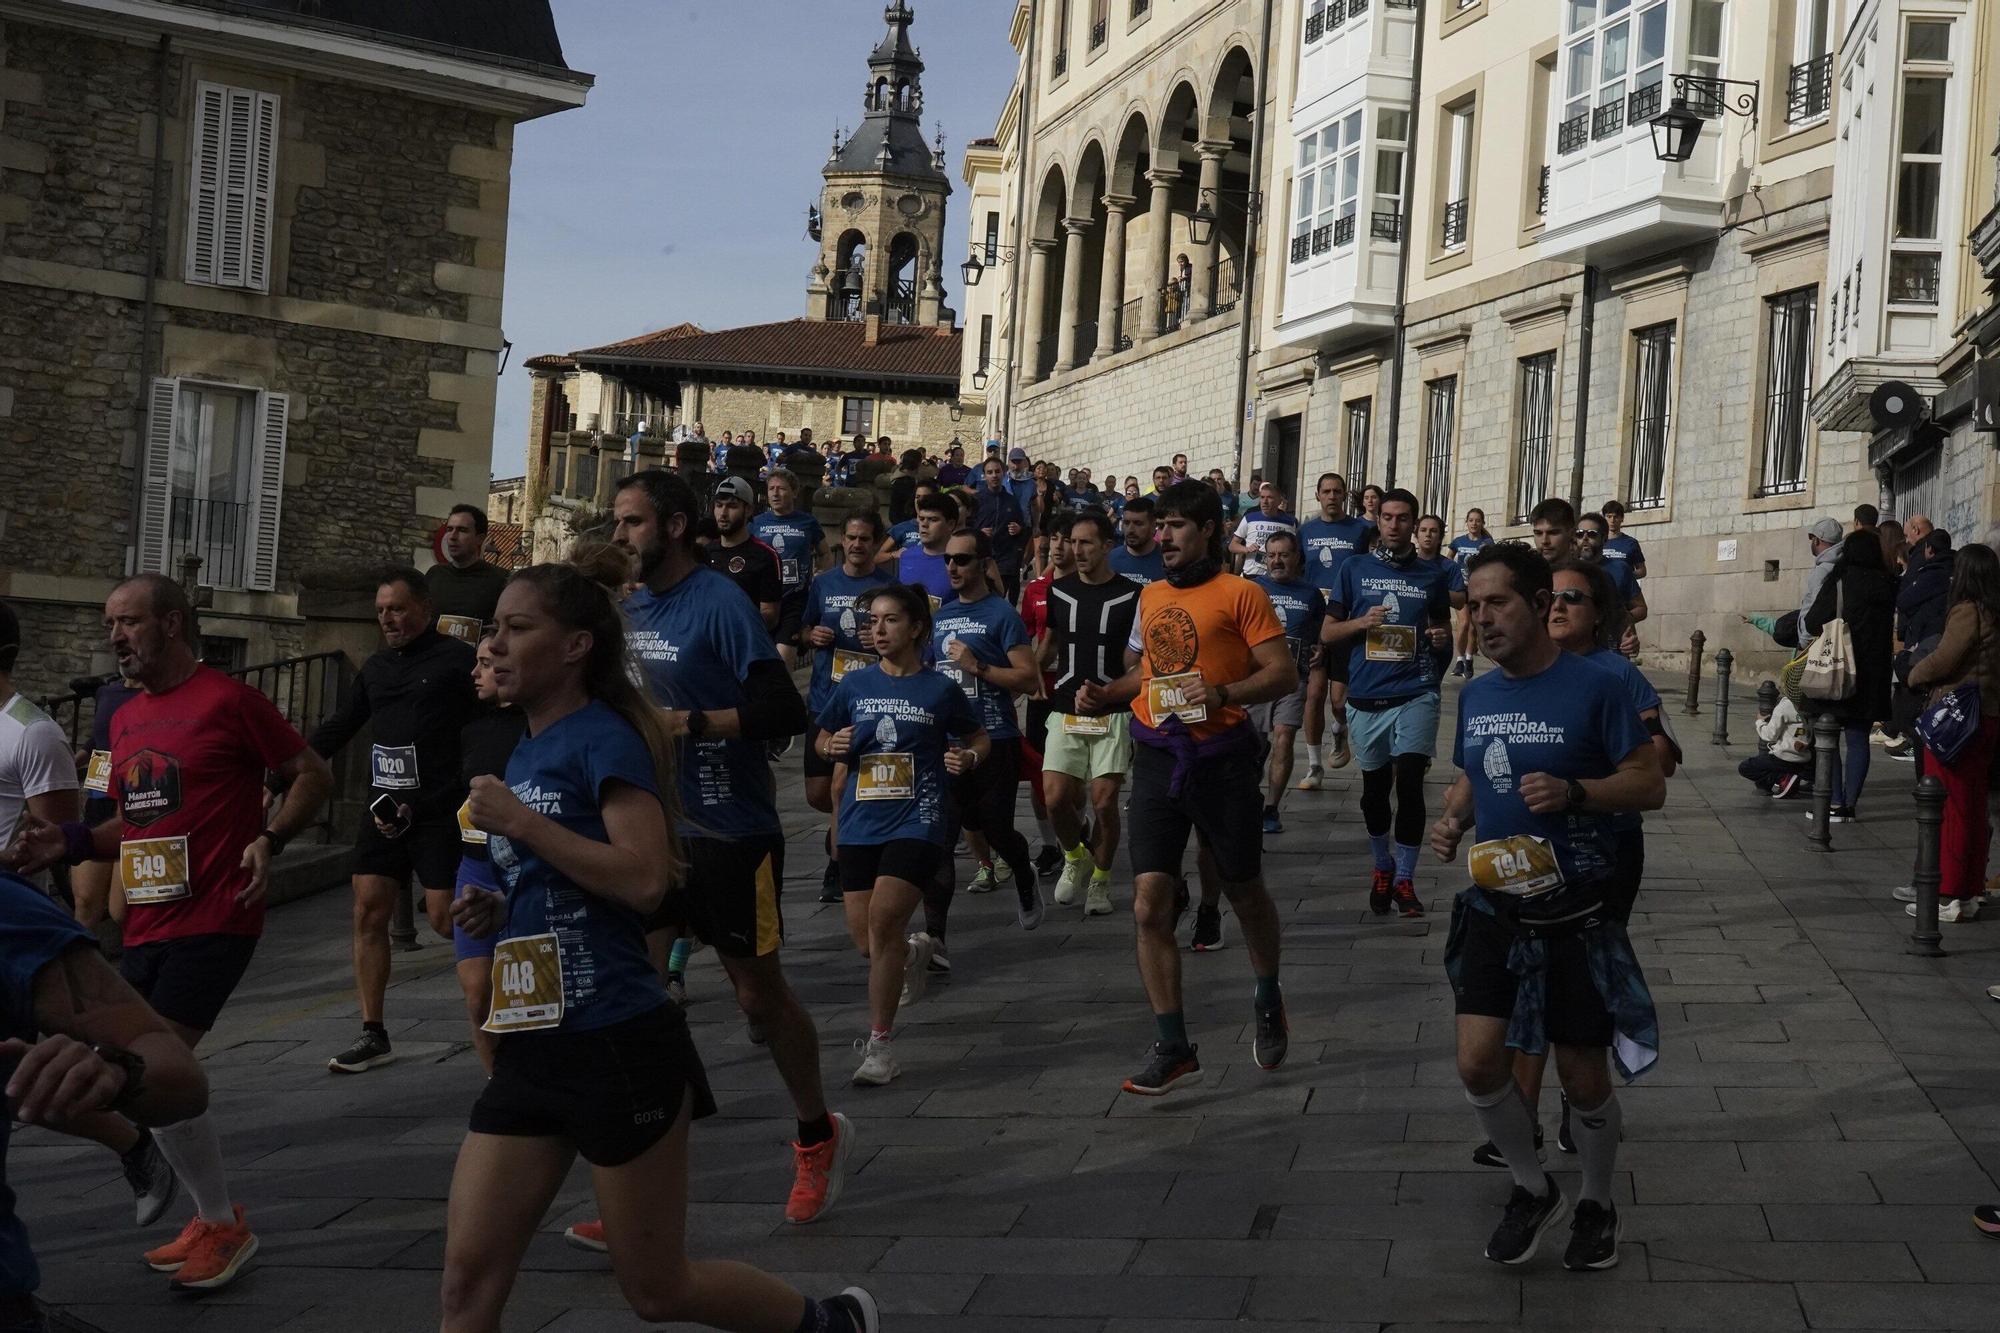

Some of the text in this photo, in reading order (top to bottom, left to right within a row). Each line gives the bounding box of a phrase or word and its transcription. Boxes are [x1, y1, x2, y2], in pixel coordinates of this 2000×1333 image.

[863, 698, 910, 706] CONQUISTA
[864, 704, 925, 716] ALMENDRA
[895, 713, 935, 725] KONKISTA
[1475, 712, 1528, 724] CONQUISTA
[1473, 721, 1548, 736] ALMENDRA
[1548, 726, 1564, 734] REN
[1508, 733, 1564, 744] KONKISTA
[377, 756, 405, 774] 1020
[871, 764, 896, 782] 107
[132, 854, 166, 880] 549
[1490, 848, 1532, 879] 194
